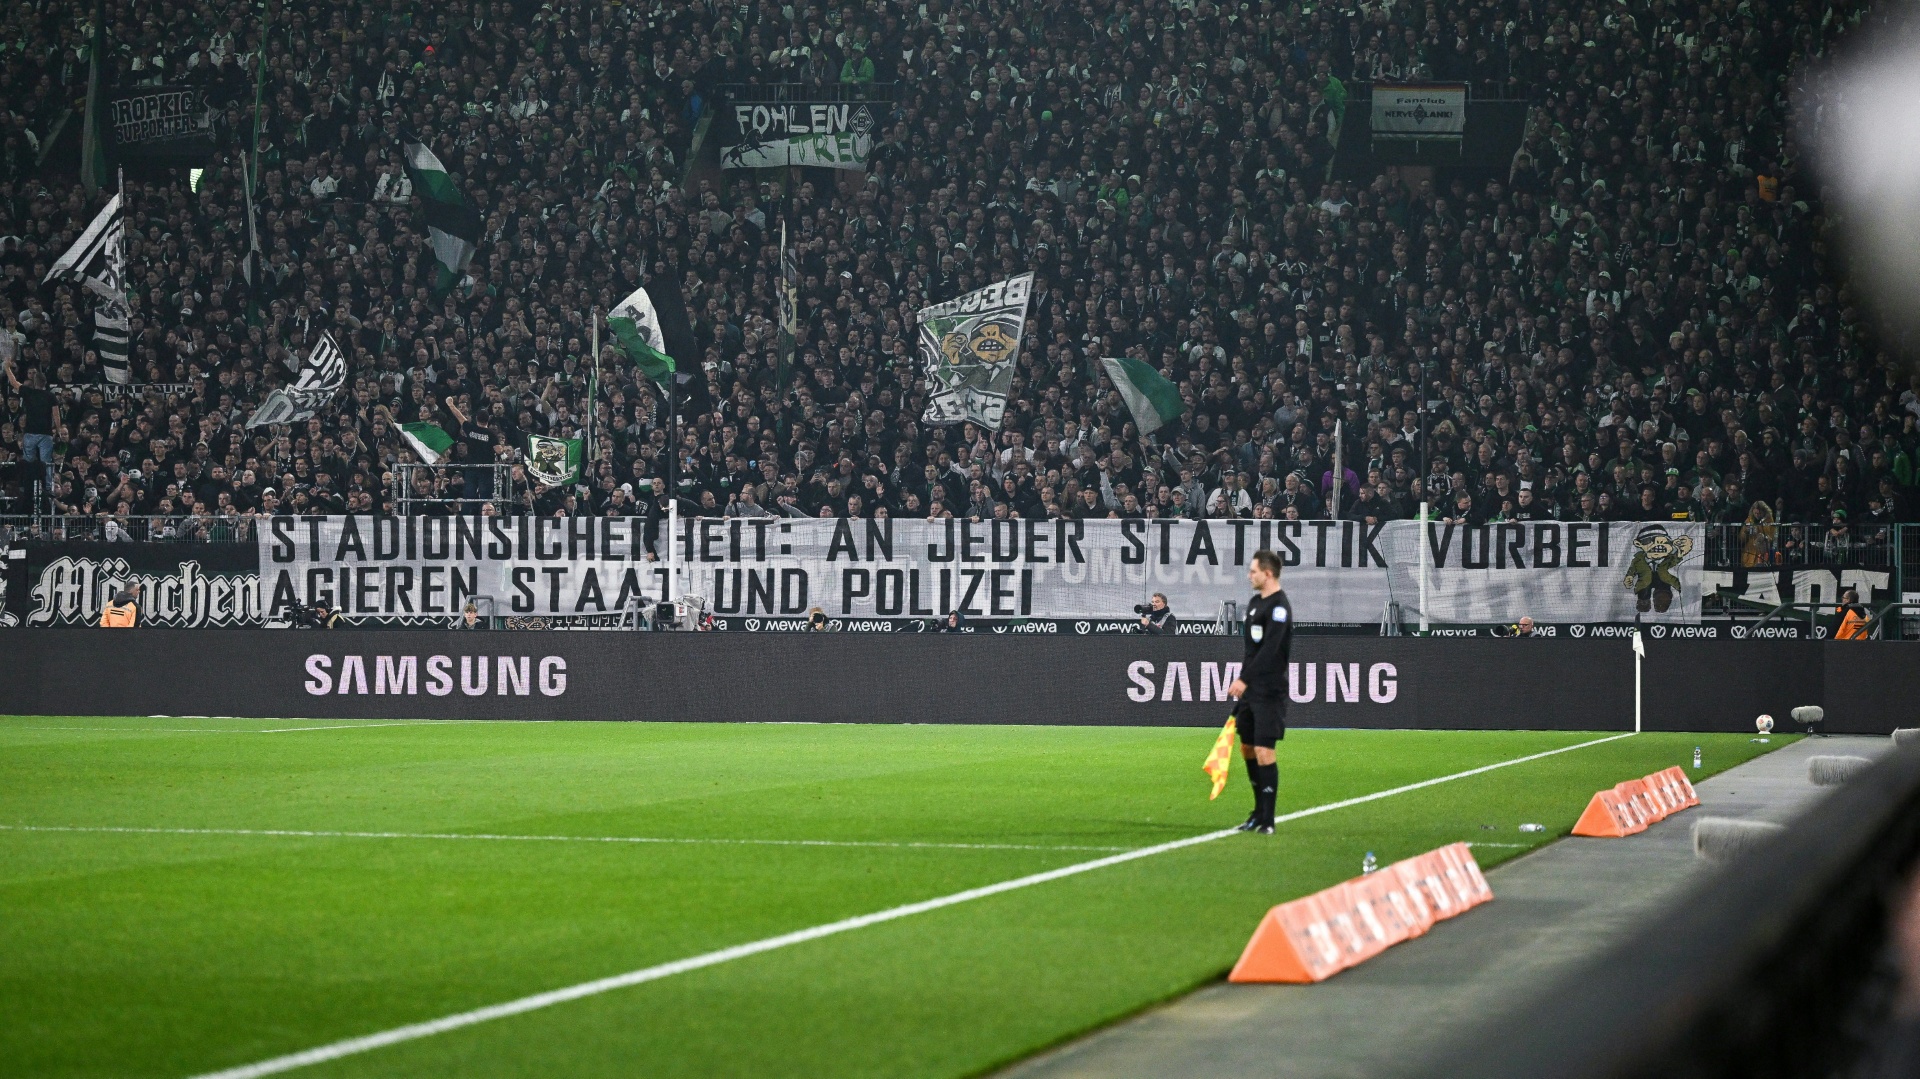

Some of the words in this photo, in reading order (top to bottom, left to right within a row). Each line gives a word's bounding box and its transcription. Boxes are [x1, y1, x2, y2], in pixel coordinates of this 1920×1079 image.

[735, 104, 850, 135] FOHLEN
[789, 132, 871, 163] TREU
[826, 518, 893, 562] AN
[928, 519, 1085, 563] JEDER
[1121, 519, 1388, 568] STATISTIK
[1428, 522, 1608, 569] VORBEI
[269, 566, 478, 616] AGIEREN
[714, 568, 808, 615] UND
[842, 568, 1032, 616] POLIZEI
[847, 621, 892, 632] mewa
[1013, 622, 1057, 633] mewa
[1671, 626, 1716, 637] mewa
[1752, 627, 1798, 638] mewa
[304, 654, 567, 696] SAMSUNG
[1126, 660, 1398, 703] SAMUNG
